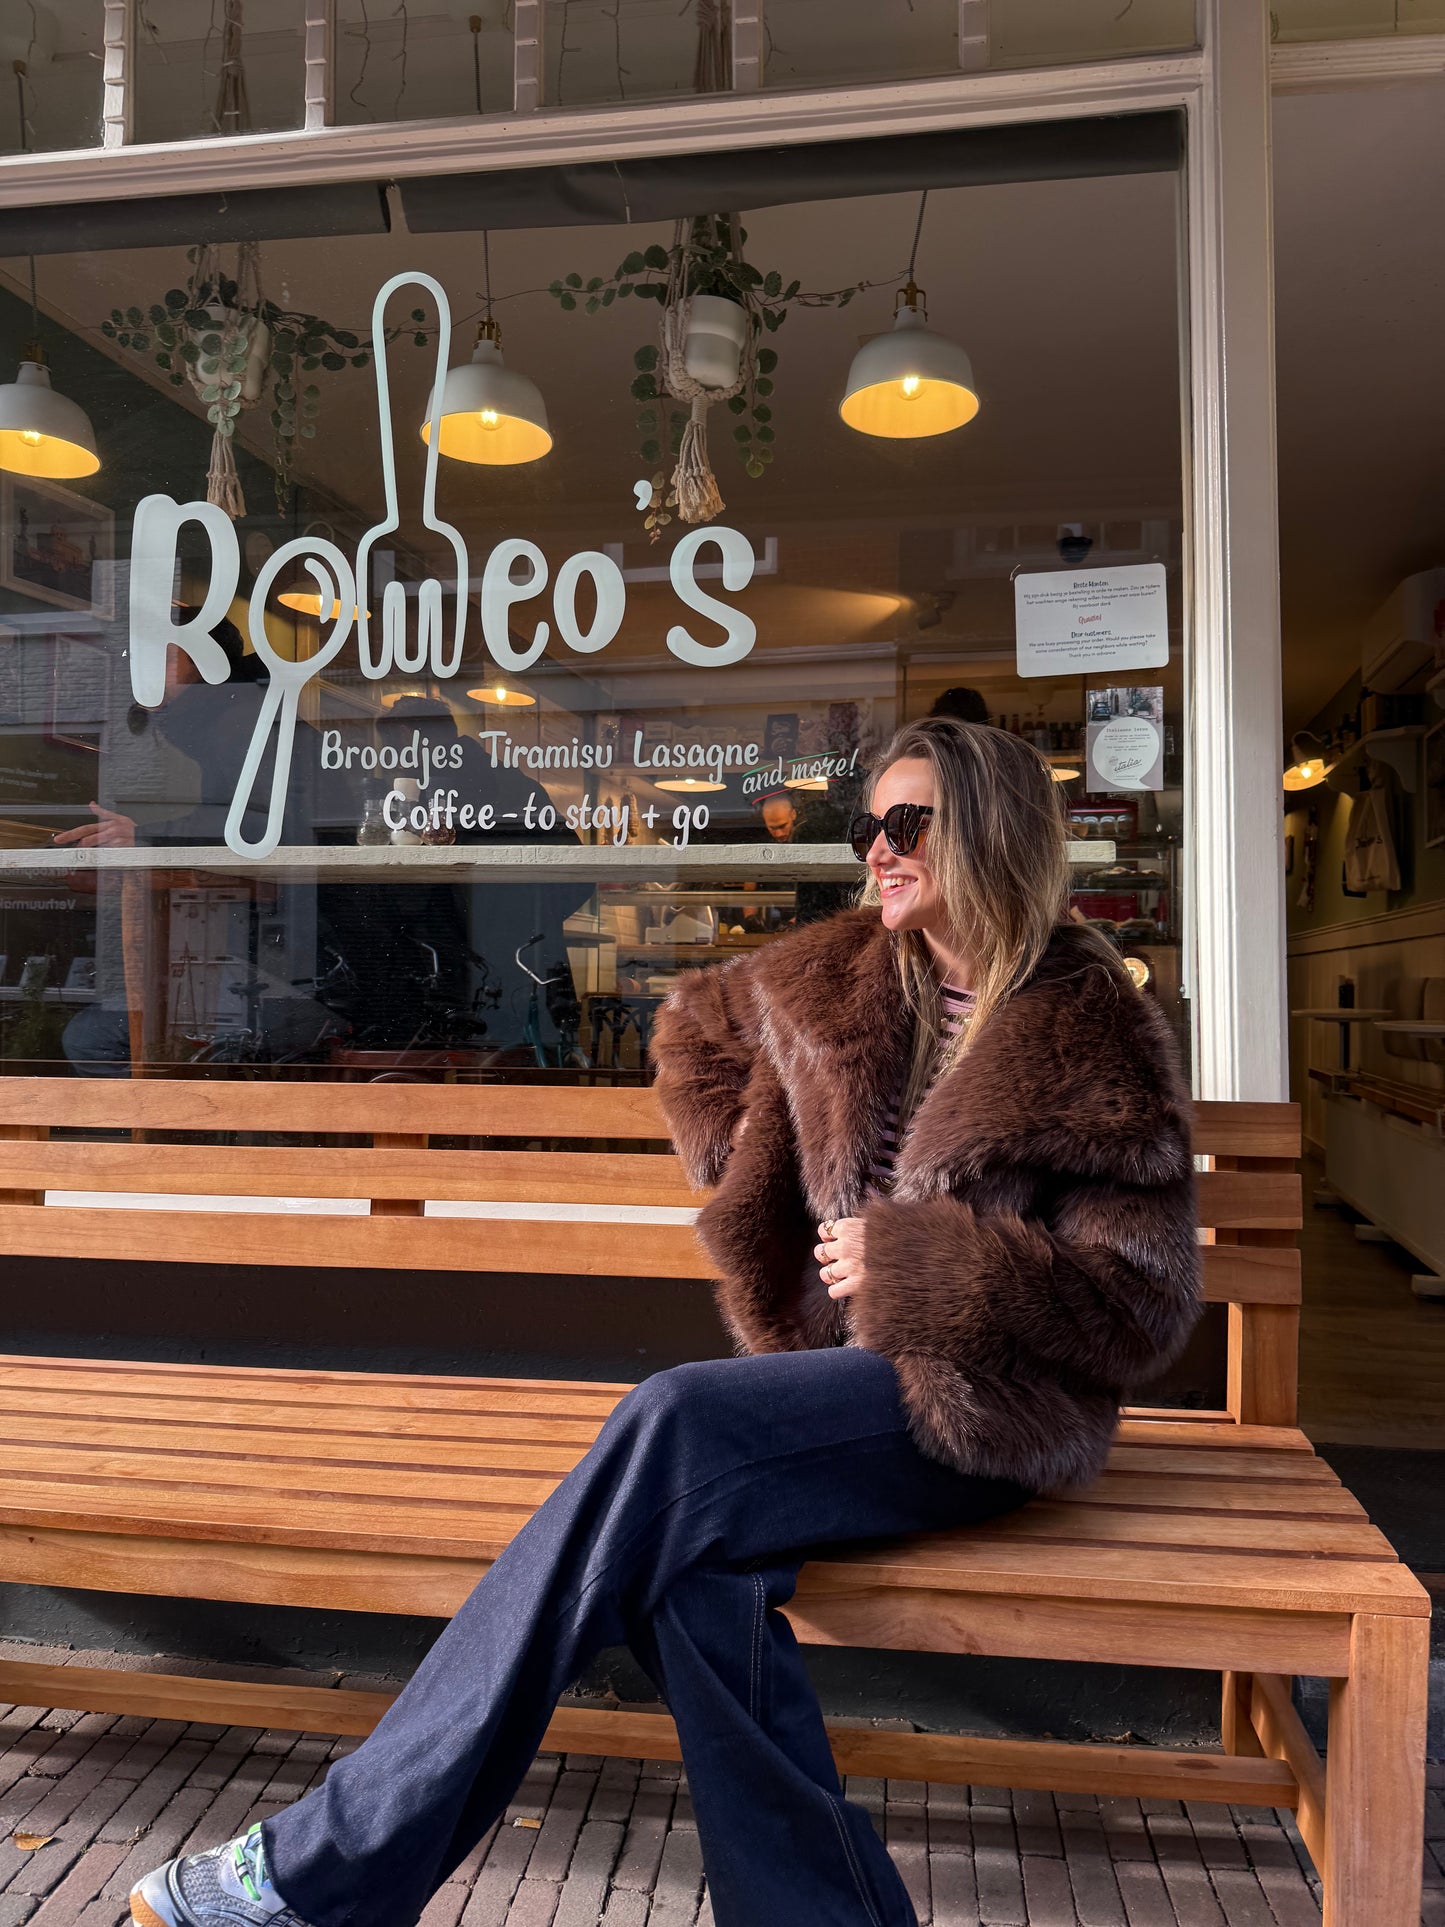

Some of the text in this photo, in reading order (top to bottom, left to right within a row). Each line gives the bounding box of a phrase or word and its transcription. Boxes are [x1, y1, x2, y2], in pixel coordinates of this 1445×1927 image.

[320, 729, 760, 790] Broodjes Tiramisu Lasagne
[742, 748, 860, 794] and more!
[565, 792, 630, 848] stay
[642, 804, 660, 830] +
[672, 804, 710, 851] go
